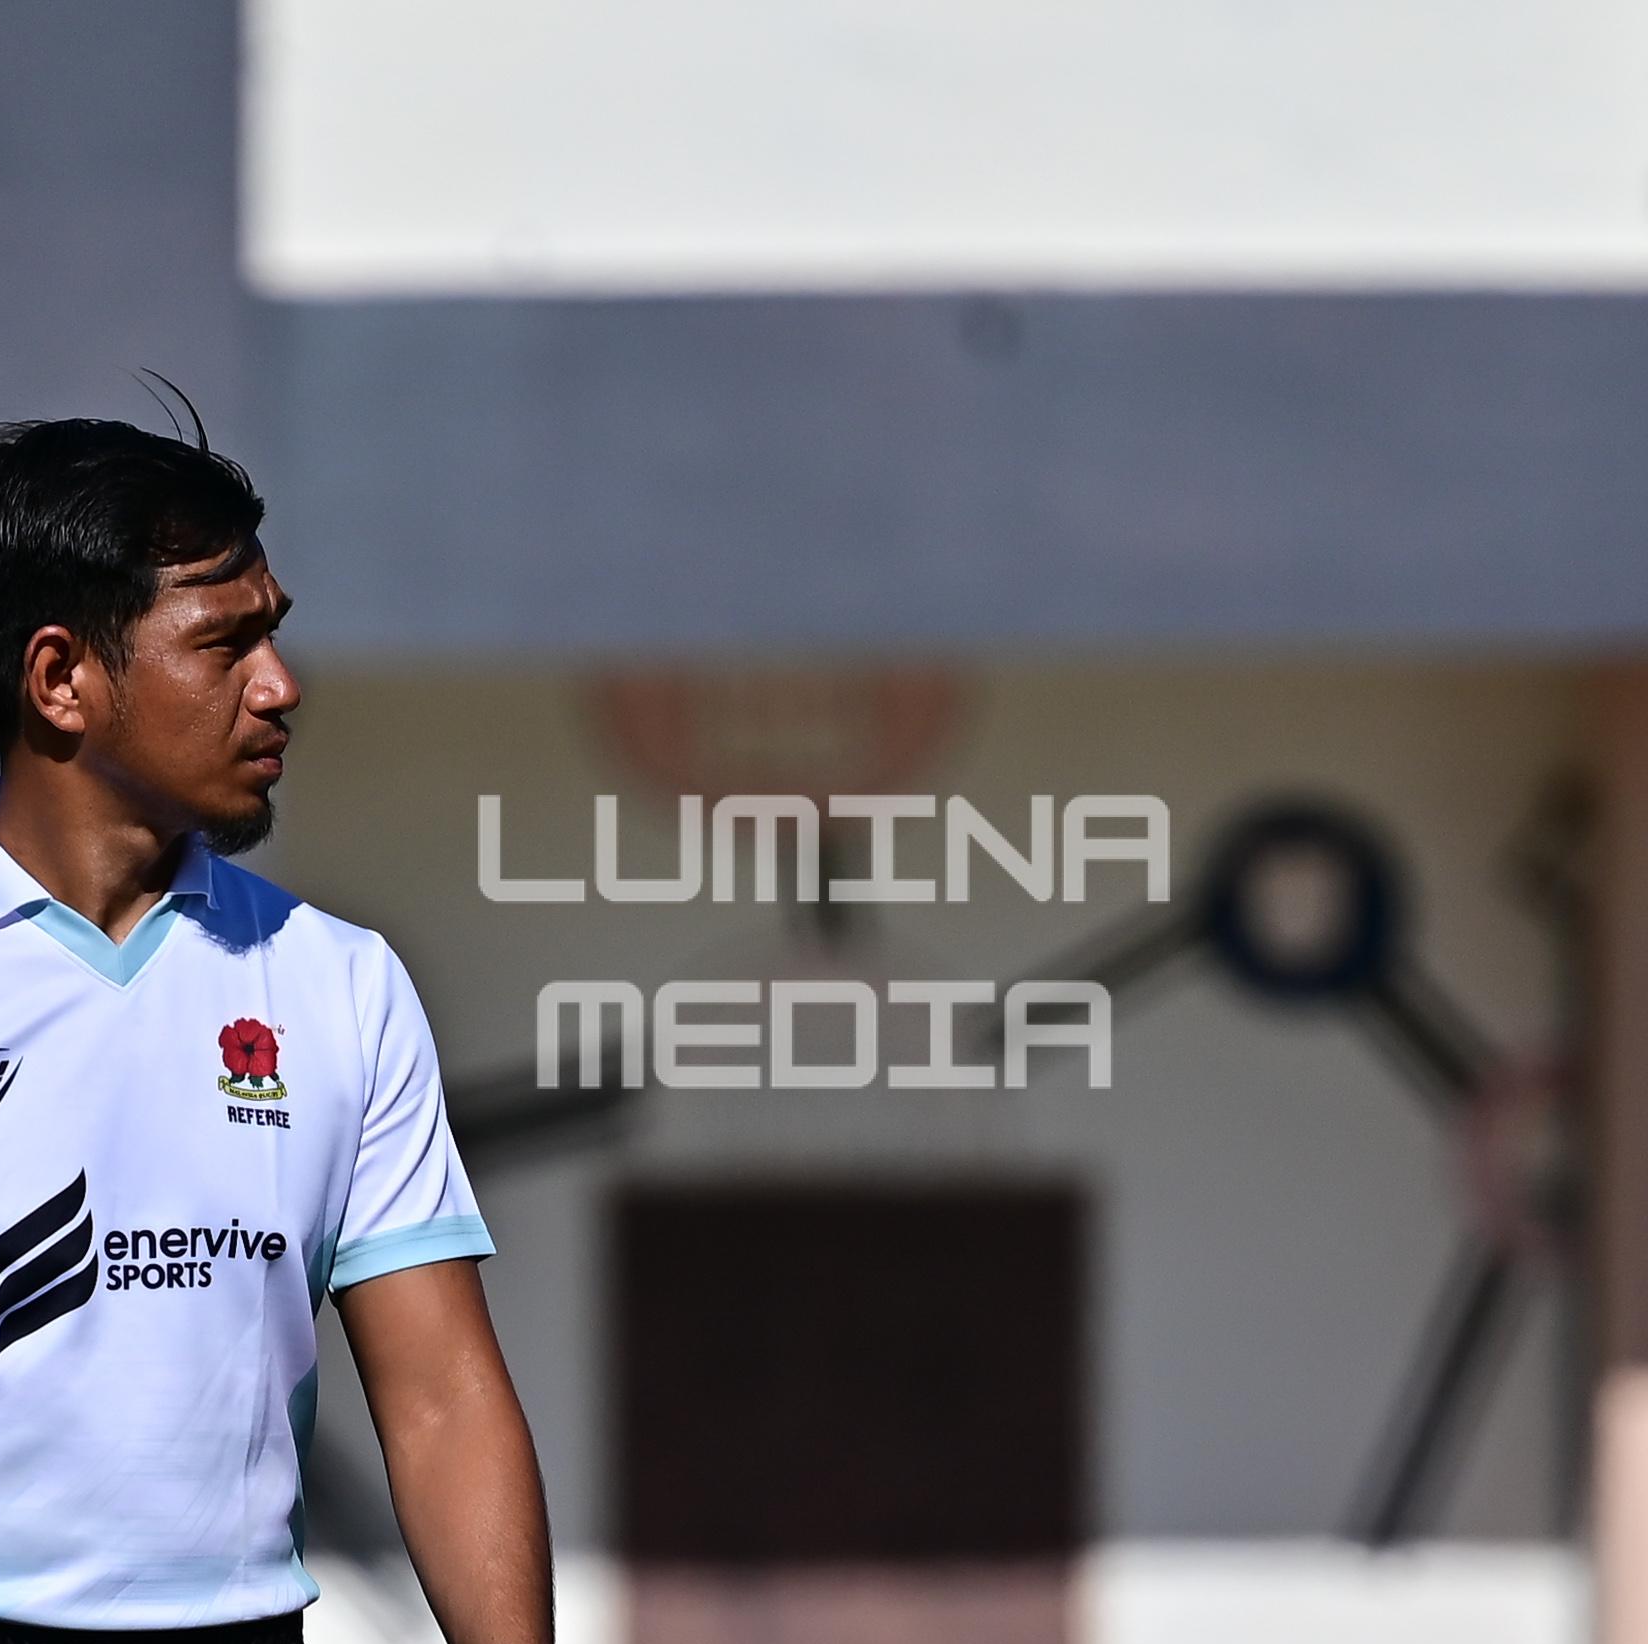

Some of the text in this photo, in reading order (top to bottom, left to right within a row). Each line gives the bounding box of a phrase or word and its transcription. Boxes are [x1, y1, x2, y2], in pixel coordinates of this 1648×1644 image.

[227, 1105, 291, 1130] REFEREE
[103, 1218, 288, 1262] enervive
[106, 1261, 212, 1291] SPORTS
